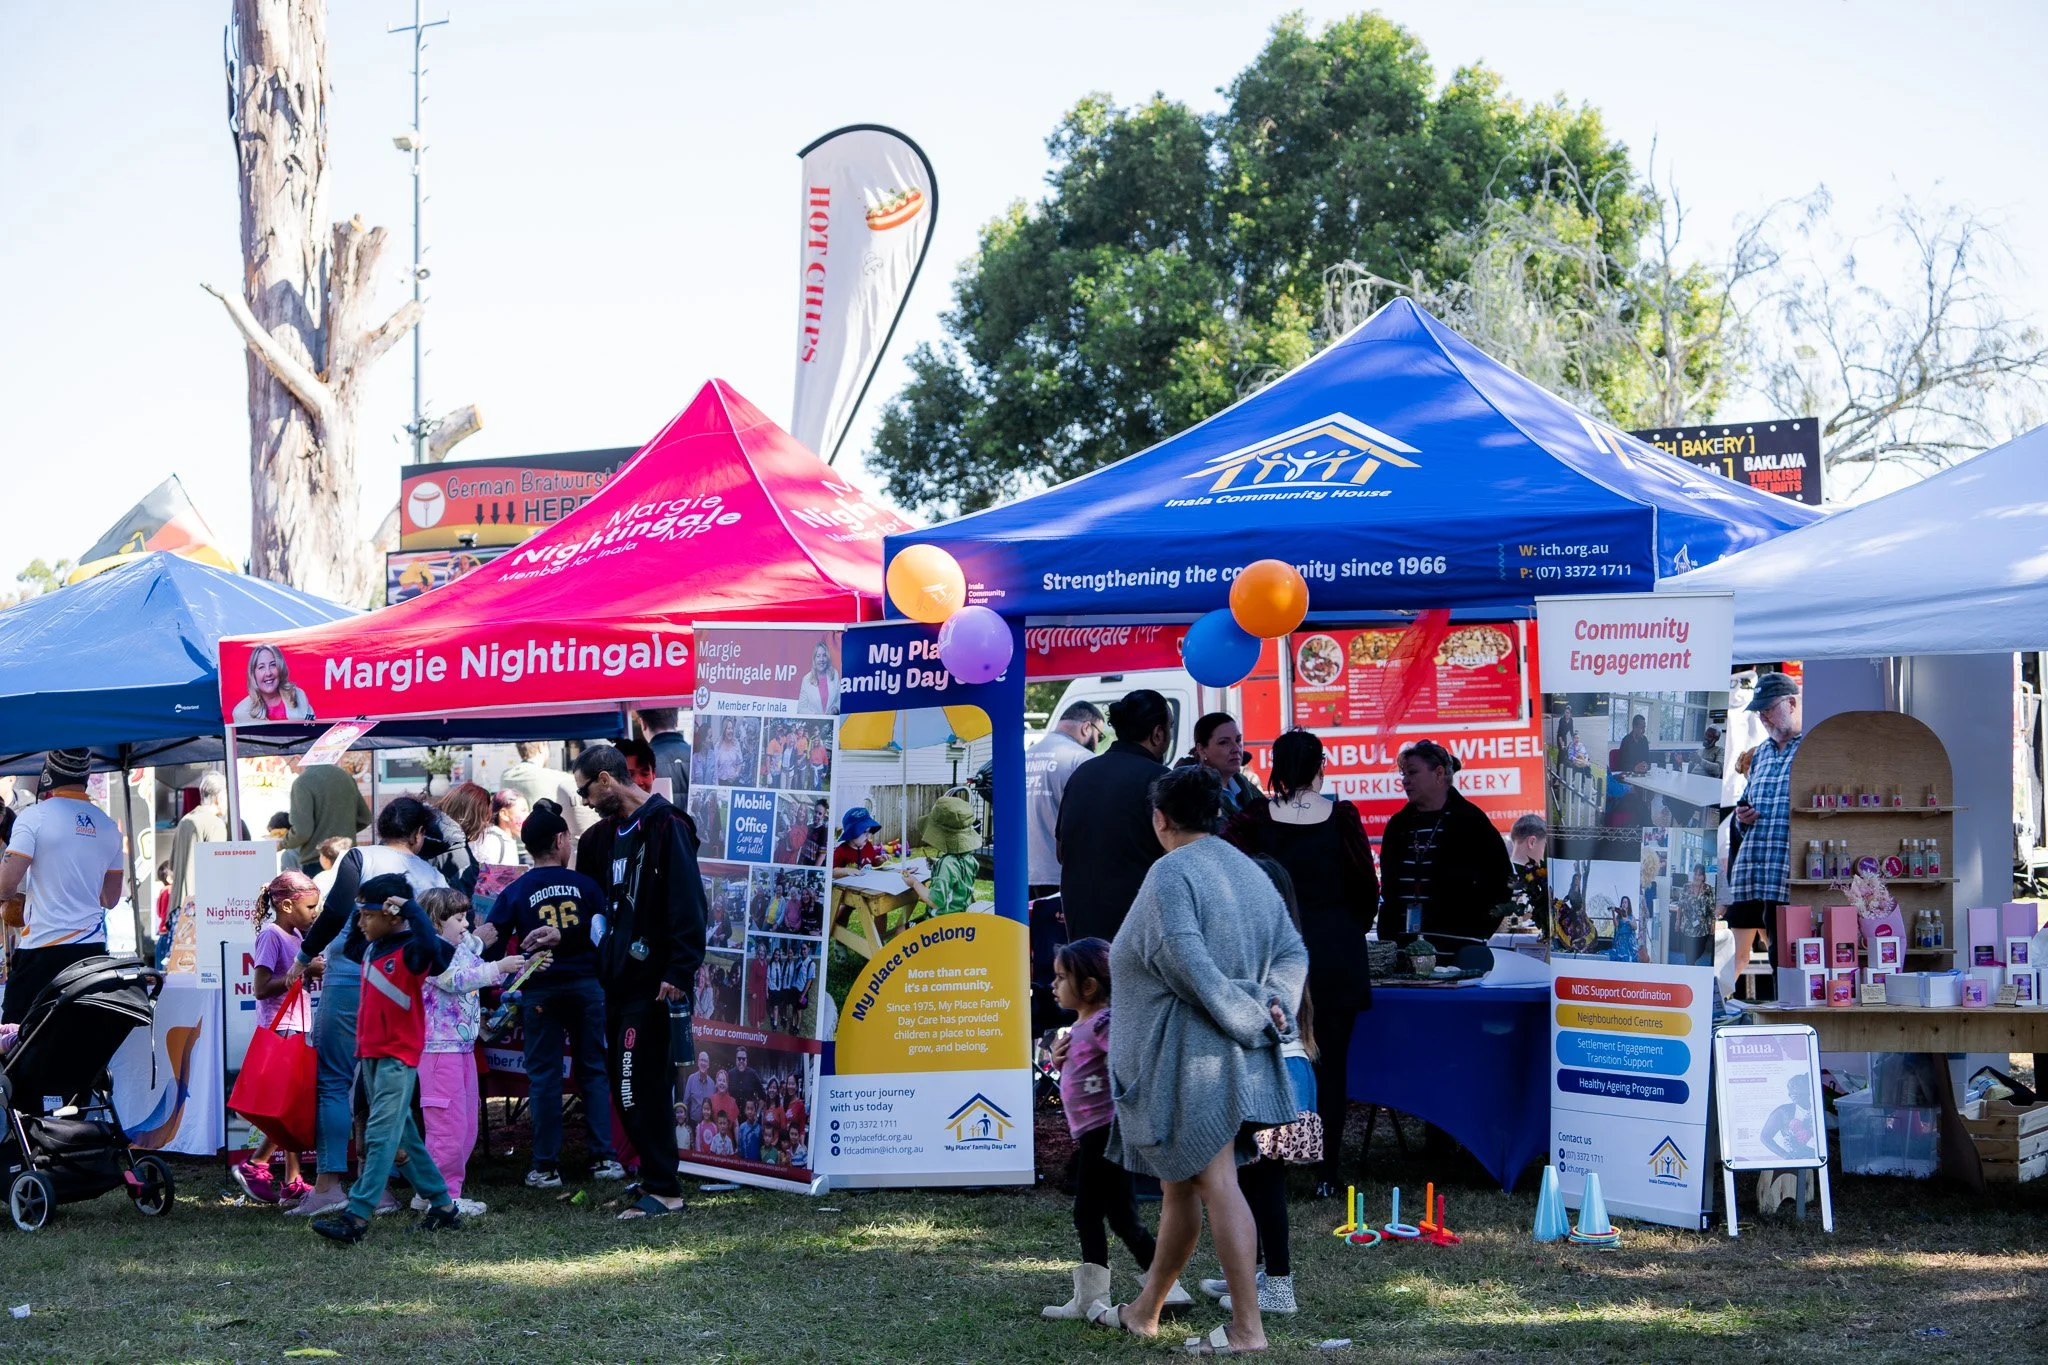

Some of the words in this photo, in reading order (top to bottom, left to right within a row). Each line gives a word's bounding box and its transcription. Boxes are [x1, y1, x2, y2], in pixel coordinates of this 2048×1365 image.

[808, 186, 831, 256] HOT
[801, 262, 826, 364] CHIPS
[1681, 435, 1744, 457] BAKERY
[1743, 453, 1806, 472] BAKLAVA
[447, 475, 515, 499] German
[520, 467, 611, 493] Bratwurst
[1749, 469, 1802, 483] TURKISH
[1164, 496, 1213, 508] Inala
[1215, 491, 1328, 504] Community
[1330, 489, 1393, 498] House
[605, 493, 722, 530] Margie
[511, 504, 742, 566] Nightingale
[658, 524, 713, 543] MP
[1519, 545, 1537, 556] W:
[1541, 543, 1609, 557] ich.org.au
[497, 562, 571, 582] Member
[571, 552, 593, 569] for
[597, 541, 638, 558] Inala
[1043, 567, 1180, 592] Strengthening
[1185, 565, 1217, 583] the
[1221, 559, 1336, 582] conity
[1340, 558, 1393, 577] since
[1397, 555, 1447, 575] 1966
[1520, 567, 1533, 579] P:
[1536, 566, 1562, 580] (07)
[1565, 565, 1597, 577] 3372
[1601, 564, 1631, 576] 1711
[968, 589, 1006, 597] Community
[1574, 616, 1690, 644] Community
[698, 640, 741, 661] Margie
[868, 643, 903, 668] My
[908, 639, 942, 662] Pla
[324, 649, 447, 693] Margie
[460, 633, 689, 683] Nightingale
[1570, 648, 1692, 676] Engagement
[696, 661, 771, 683] Nightingale
[774, 665, 797, 682] MP
[840, 671, 901, 696] amily
[906, 667, 949, 692] Day
[717, 699, 750, 712] Member
[752, 701, 766, 712] For
[767, 701, 787, 713] Inala
[1259, 743, 1394, 770] ISNBUL
[1451, 736, 1544, 761] WHEEL
[1331, 779, 1404, 795] TURKIS
[1459, 774, 1511, 790] KERY
[733, 794, 772, 810] Mobile
[735, 816, 768, 833] Office
[227, 897, 257, 908] Margie
[529, 885, 582, 908] BROOKLYN
[852, 991, 876, 1022] My
[867, 953, 903, 996] place
[902, 941, 920, 959] to
[920, 926, 976, 948] belong
[908, 969, 934, 980] More
[937, 967, 961, 978] than
[964, 967, 988, 977] care
[922, 984, 928, 992] a
[930, 980, 994, 993] community.
[1571, 984, 1590, 996] NDIS
[1591, 986, 1620, 999] Support
[1621, 987, 1672, 1001] Coordination
[886, 1002, 911, 1012] Since
[913, 1001, 936, 1012] 1975,
[938, 1001, 952, 1012] My
[954, 999, 978, 1010] Place
[980, 998, 1011, 1010] Family
[897, 1016, 916, 1027] Day
[918, 1016, 938, 1025] Care
[939, 1014, 956, 1024] has
[957, 1012, 999, 1025] provided
[1577, 1012, 1633, 1026] Neighbourhood
[1634, 1016, 1663, 1028] Centres
[703, 1025, 713, 1035] for
[714, 1027, 727, 1037] our
[727, 1029, 768, 1044] community
[894, 1029, 931, 1040] children
[939, 1029, 964, 1041] place
[966, 1028, 975, 1037] to
[977, 1027, 1003, 1037] learn,
[908, 1044, 933, 1055] grow,
[935, 1042, 953, 1052] and
[954, 1041, 989, 1053] belong.
[1577, 1038, 1616, 1051] Settlement
[1617, 1041, 1664, 1056] Engagement
[1586, 1052, 1622, 1065] Transition
[1623, 1056, 1653, 1069] Support
[830, 1088, 852, 1099] Start
[855, 1089, 877, 1100] your
[878, 1087, 916, 1100] journey
[1579, 1077, 1606, 1093] Healthy
[1606, 1080, 1631, 1095] Ageing
[1632, 1082, 1665, 1097] Program
[830, 1102, 850, 1113] with
[853, 1103, 864, 1112] us
[866, 1101, 894, 1113] today
[843, 1120, 858, 1130] (07)
[859, 1120, 878, 1129] 3372
[879, 1119, 897, 1128] 1711
[844, 1133, 913, 1144] myplacefdc.org.au
[1558, 1131, 1583, 1144] Contact
[1584, 1137, 1592, 1145] us
[844, 1145, 924, 1156] fdcadmin@ich.org.au
[1565, 1150, 1576, 1159] (07)
[1577, 1151, 1590, 1162] 3372
[1657, 1179, 1677, 1188] Community
